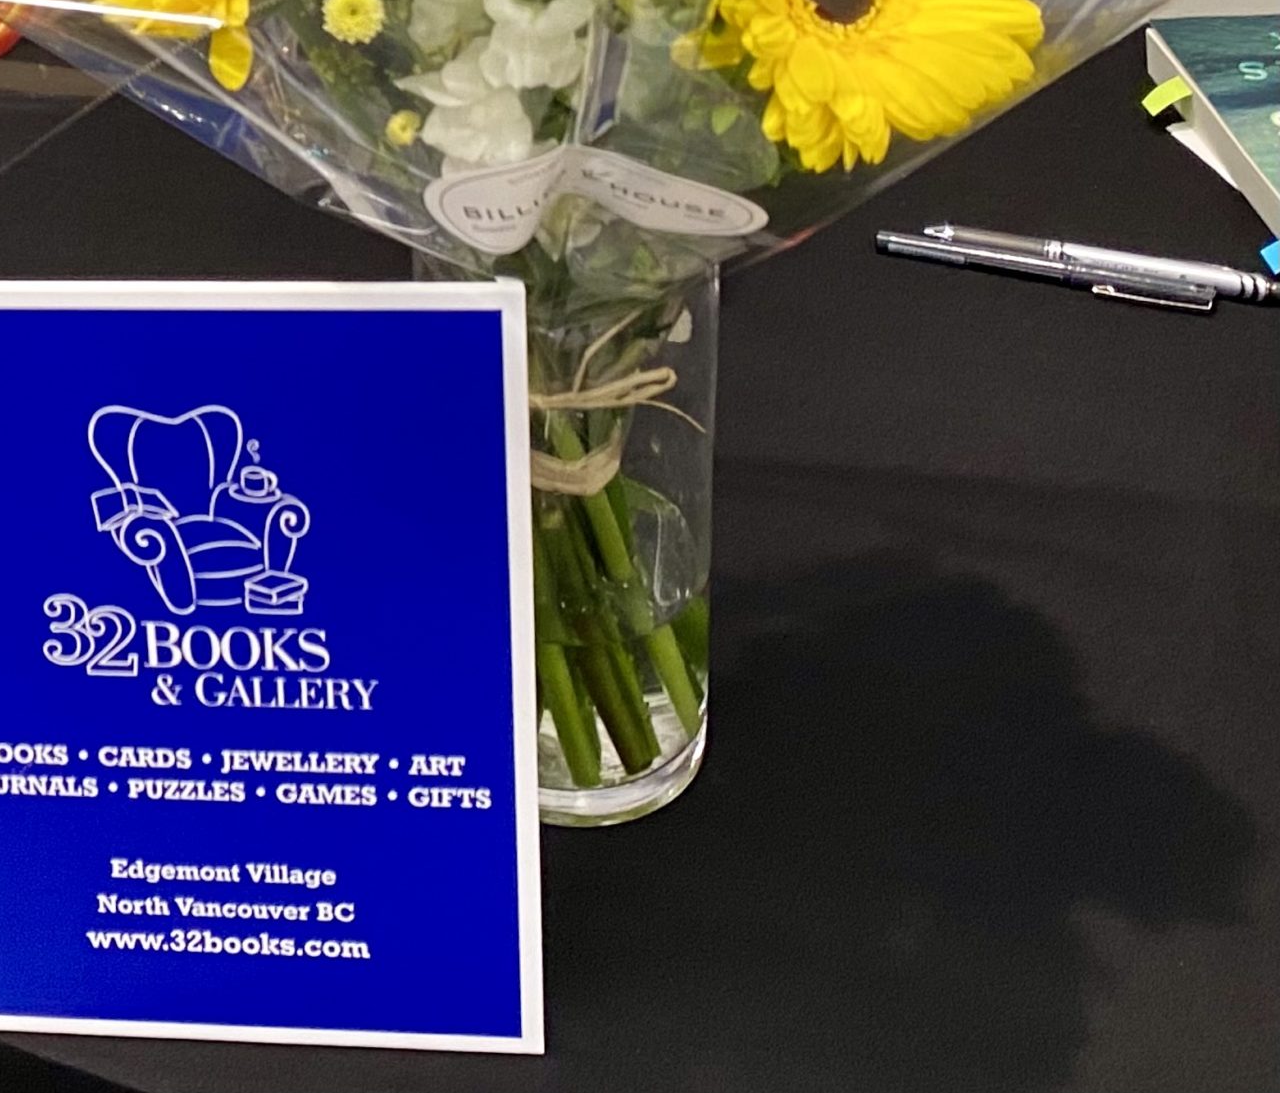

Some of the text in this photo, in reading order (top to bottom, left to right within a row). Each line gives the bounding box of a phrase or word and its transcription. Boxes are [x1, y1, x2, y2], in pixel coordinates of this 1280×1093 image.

[609, 182, 726, 218] HOUSE
[43, 594, 331, 676] 32 BOOKS
[150, 672, 380, 711] & GALLERY
[97, 745, 193, 770] CARDS
[220, 749, 380, 775] JEWELLERY
[408, 754, 466, 777] ART
[127, 778, 246, 803] PUZZLES
[275, 782, 378, 807] GAMES
[407, 786, 492, 810] GIFTS
[109, 857, 337, 889] Edgemont Village
[96, 892, 357, 924] North Vancouver BC
[86, 928, 371, 959] www.32books.com
